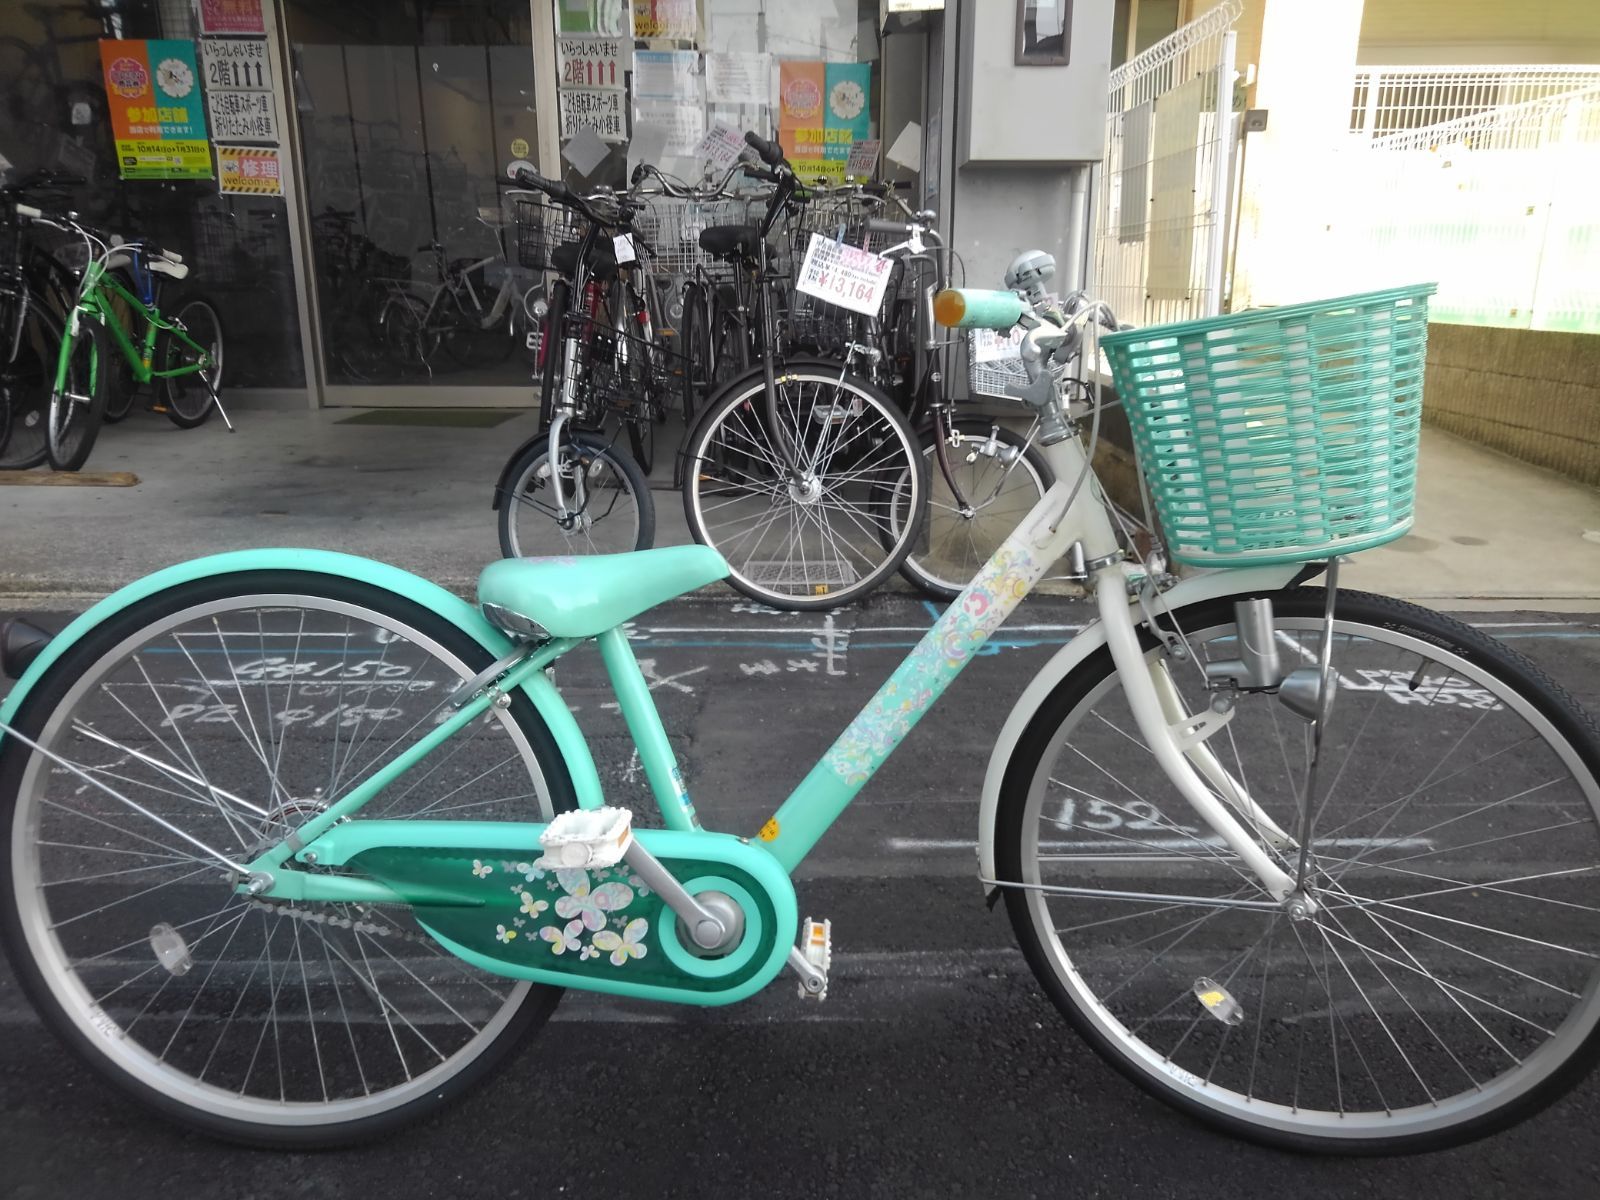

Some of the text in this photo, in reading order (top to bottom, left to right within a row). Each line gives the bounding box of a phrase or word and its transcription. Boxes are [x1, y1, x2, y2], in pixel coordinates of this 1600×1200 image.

[204, 42, 263, 58] いらっしゃいませ
[561, 41, 618, 57] いらっしゃいませ
[210, 59, 231, 87] 2階
[564, 59, 584, 85] 2階
[563, 92, 619, 115] こども自転車スポーツ車
[242, 159, 278, 177] 修理
[224, 177, 270, 187] welcome
[818, 270, 874, 303] ¥13,164
